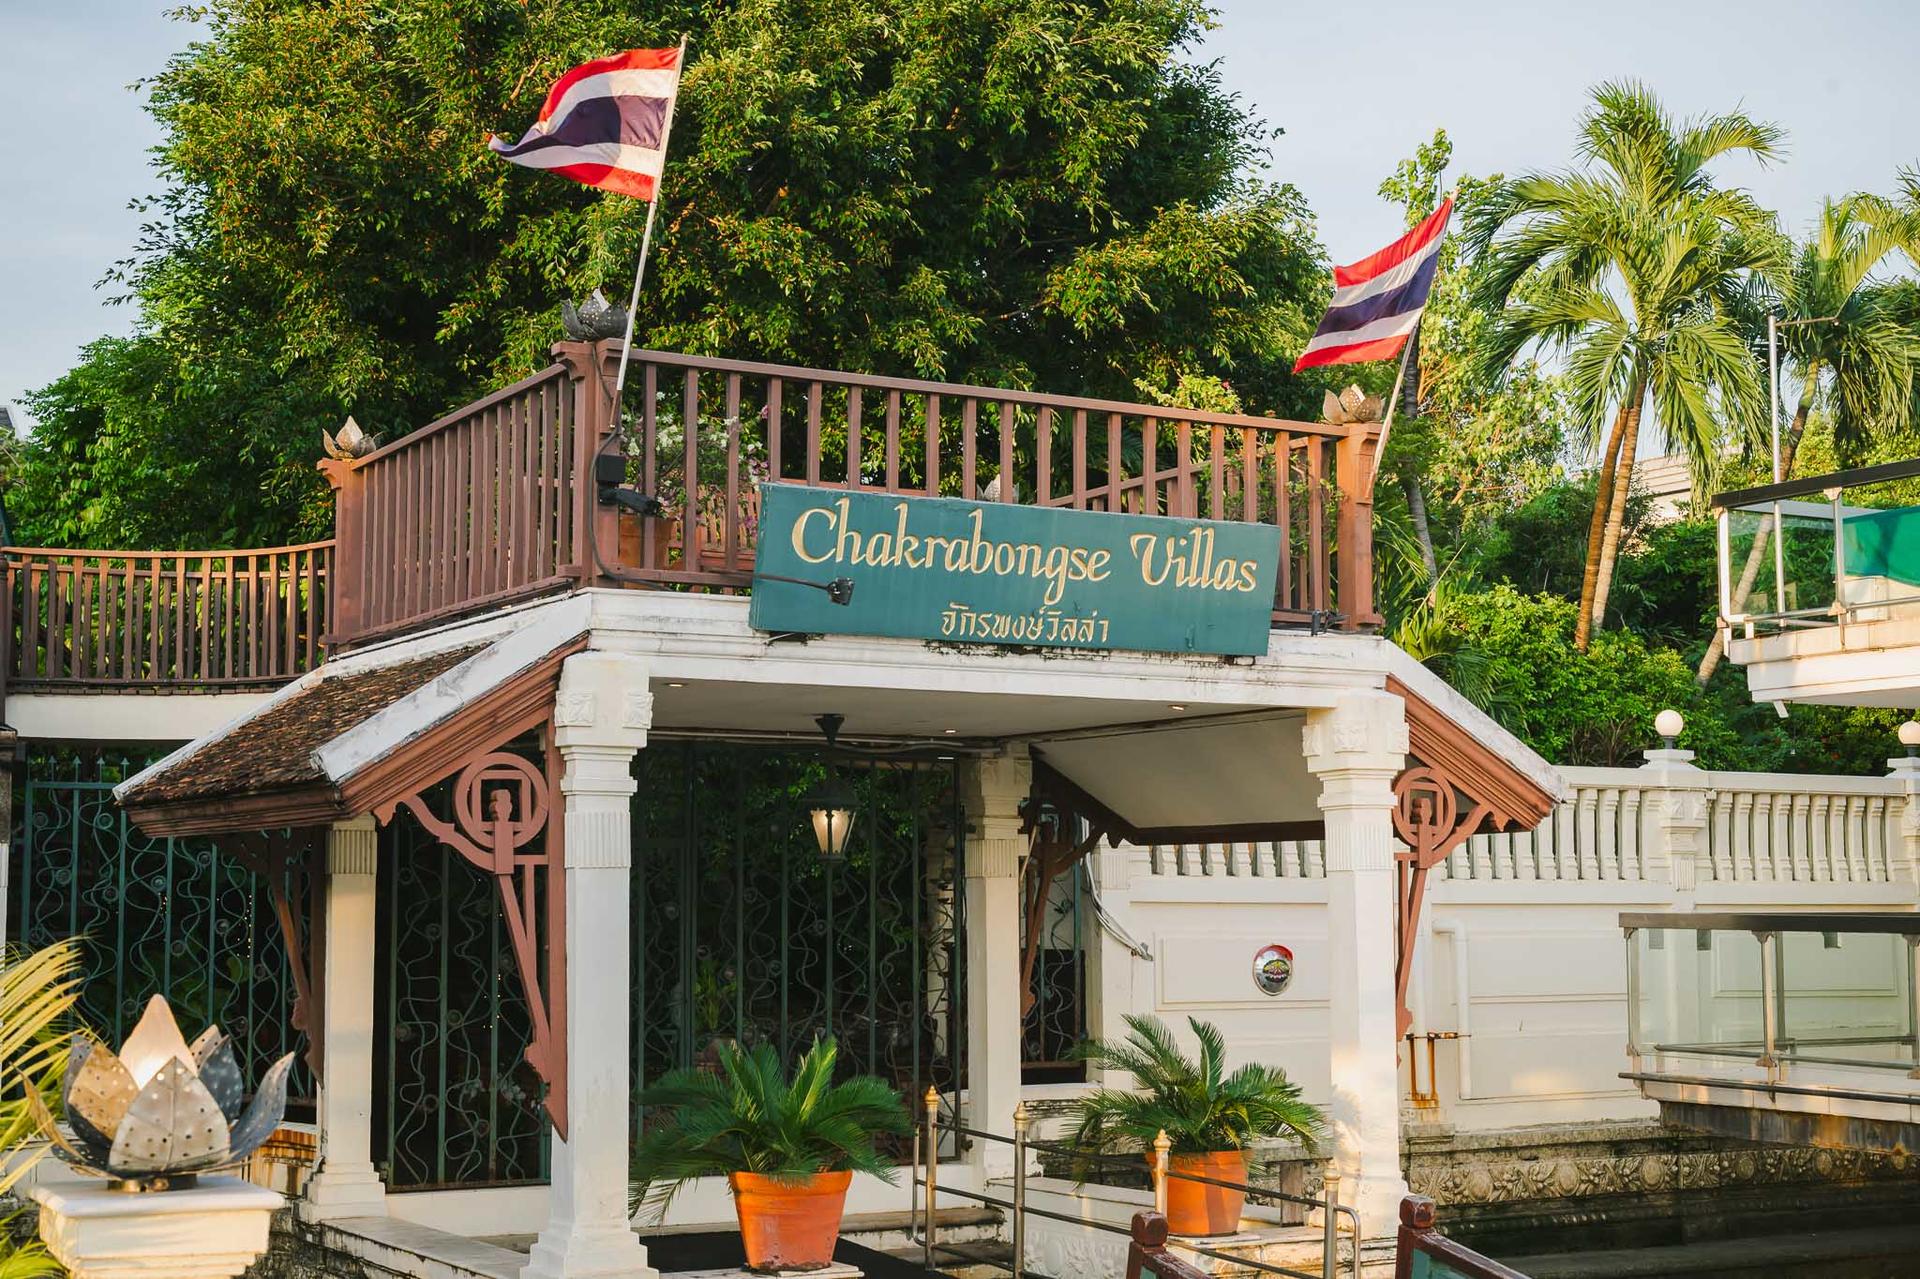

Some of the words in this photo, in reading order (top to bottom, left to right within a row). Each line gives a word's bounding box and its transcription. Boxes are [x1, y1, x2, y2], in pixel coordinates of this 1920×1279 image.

[791, 497, 1111, 605] Chakrabongse
[1130, 527, 1258, 592] Villas
[941, 602, 1109, 643] จักรพงษ์วิลล่า
